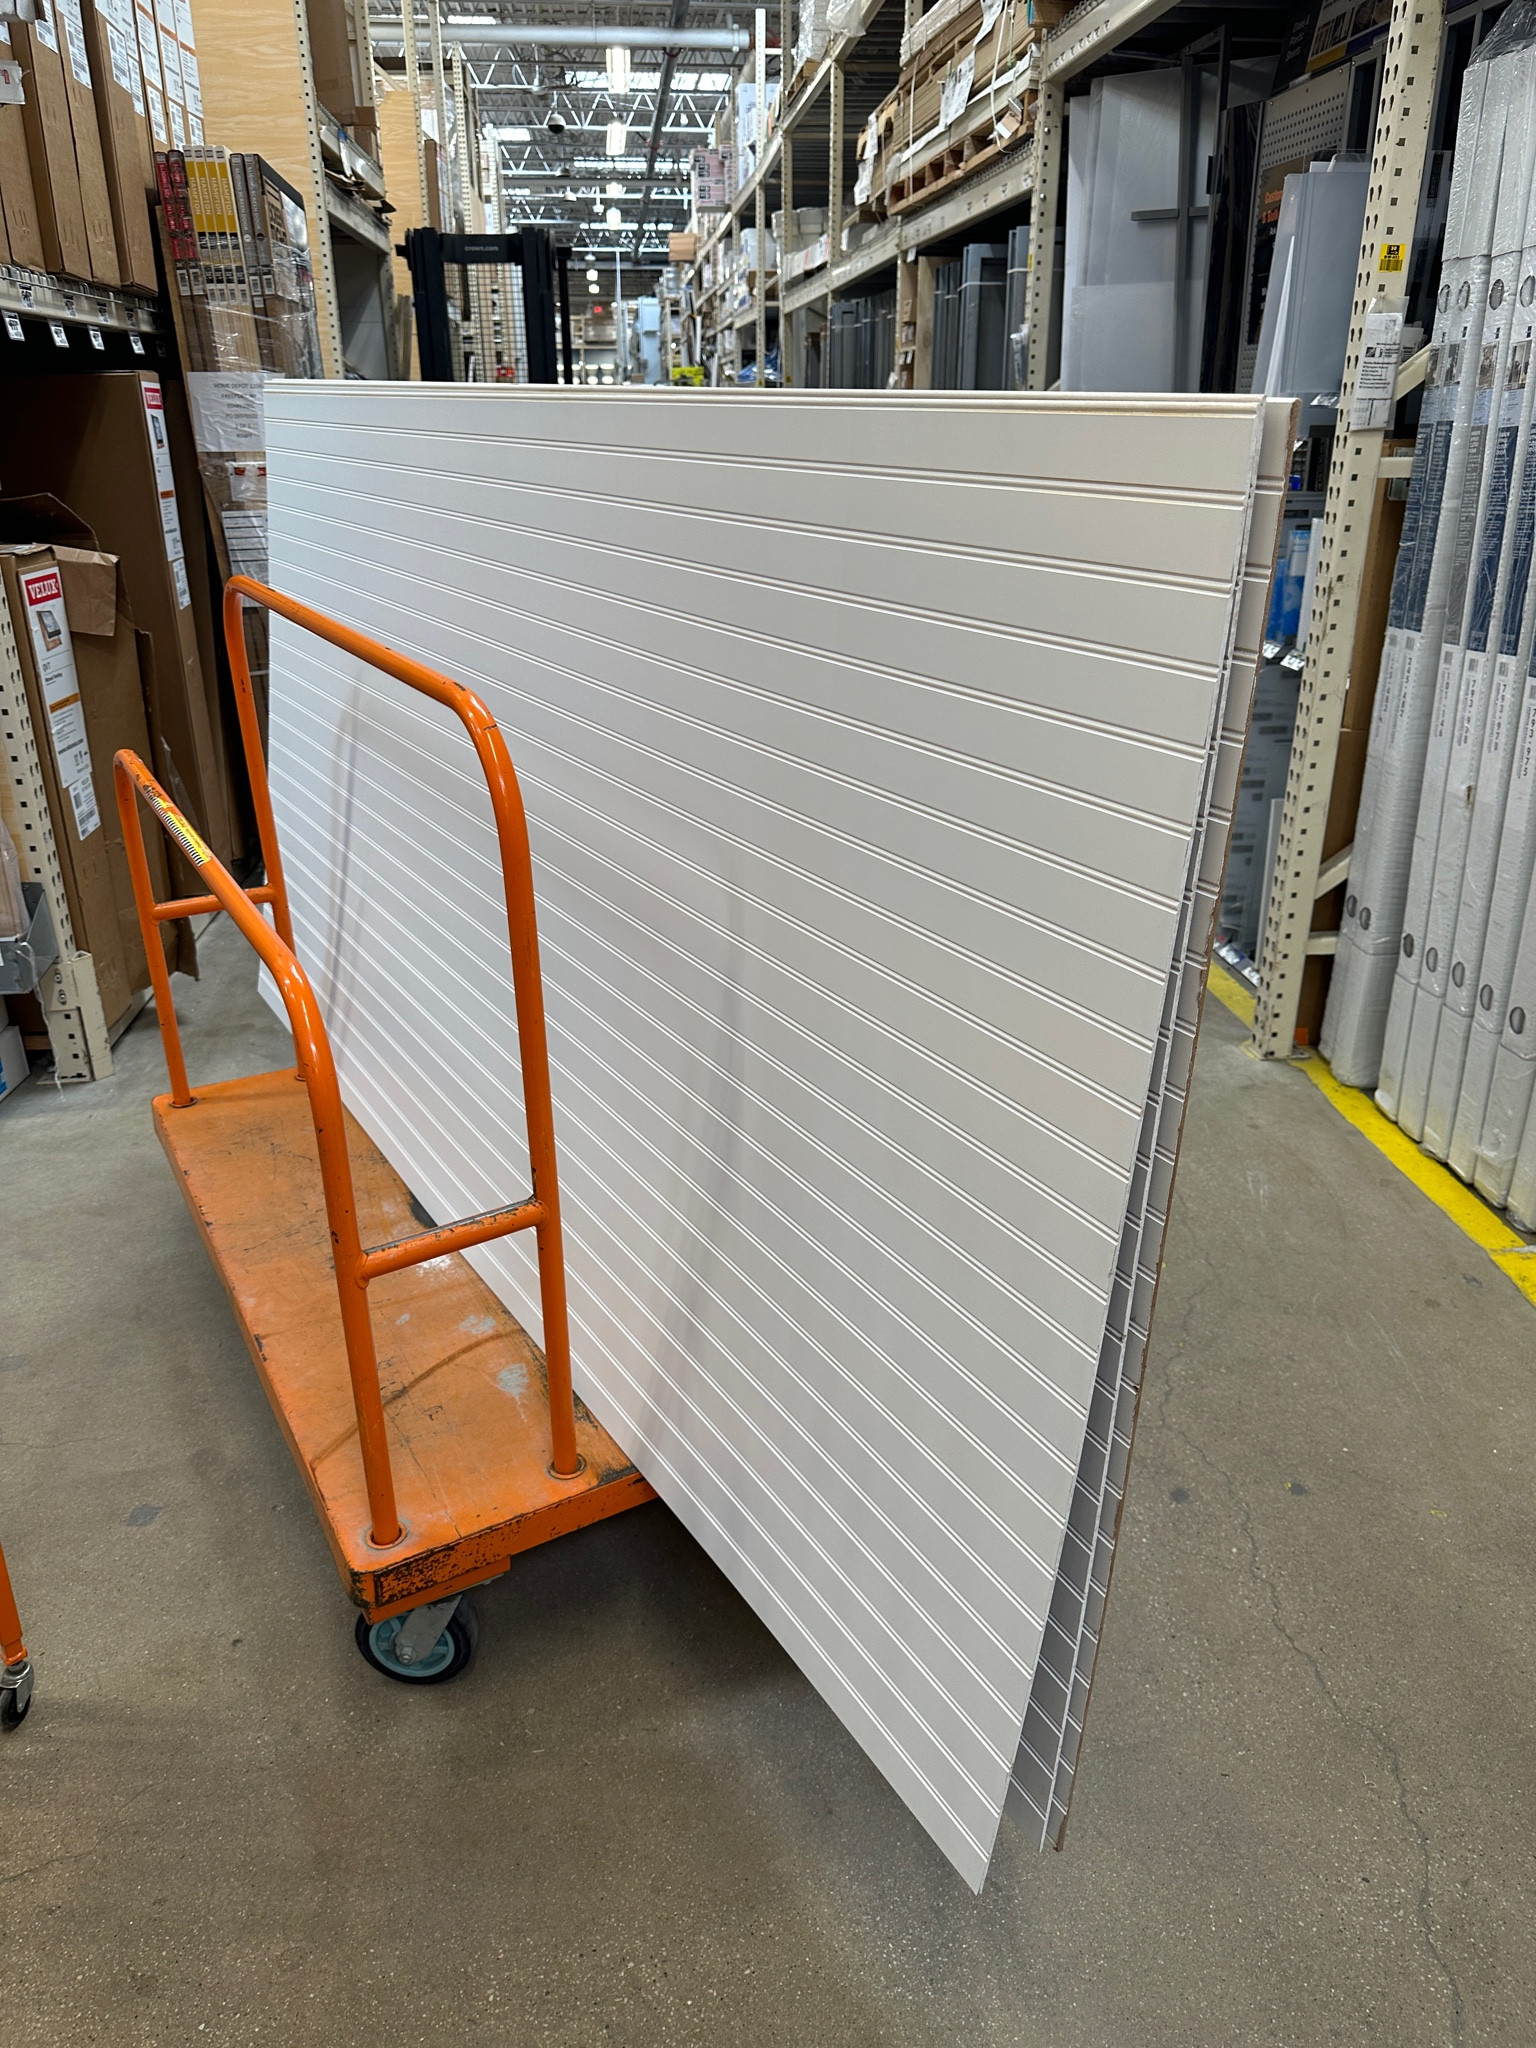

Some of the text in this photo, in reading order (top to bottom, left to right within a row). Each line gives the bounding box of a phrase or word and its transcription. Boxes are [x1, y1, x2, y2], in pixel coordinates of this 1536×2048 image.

[190, 177, 202, 215] HAMPTON
[200, 177, 212, 215] HAMPTON
[211, 177, 222, 215] HAMPTON
[222, 178, 233, 216] HAMPTON
[28, 579, 58, 599] VELUX
